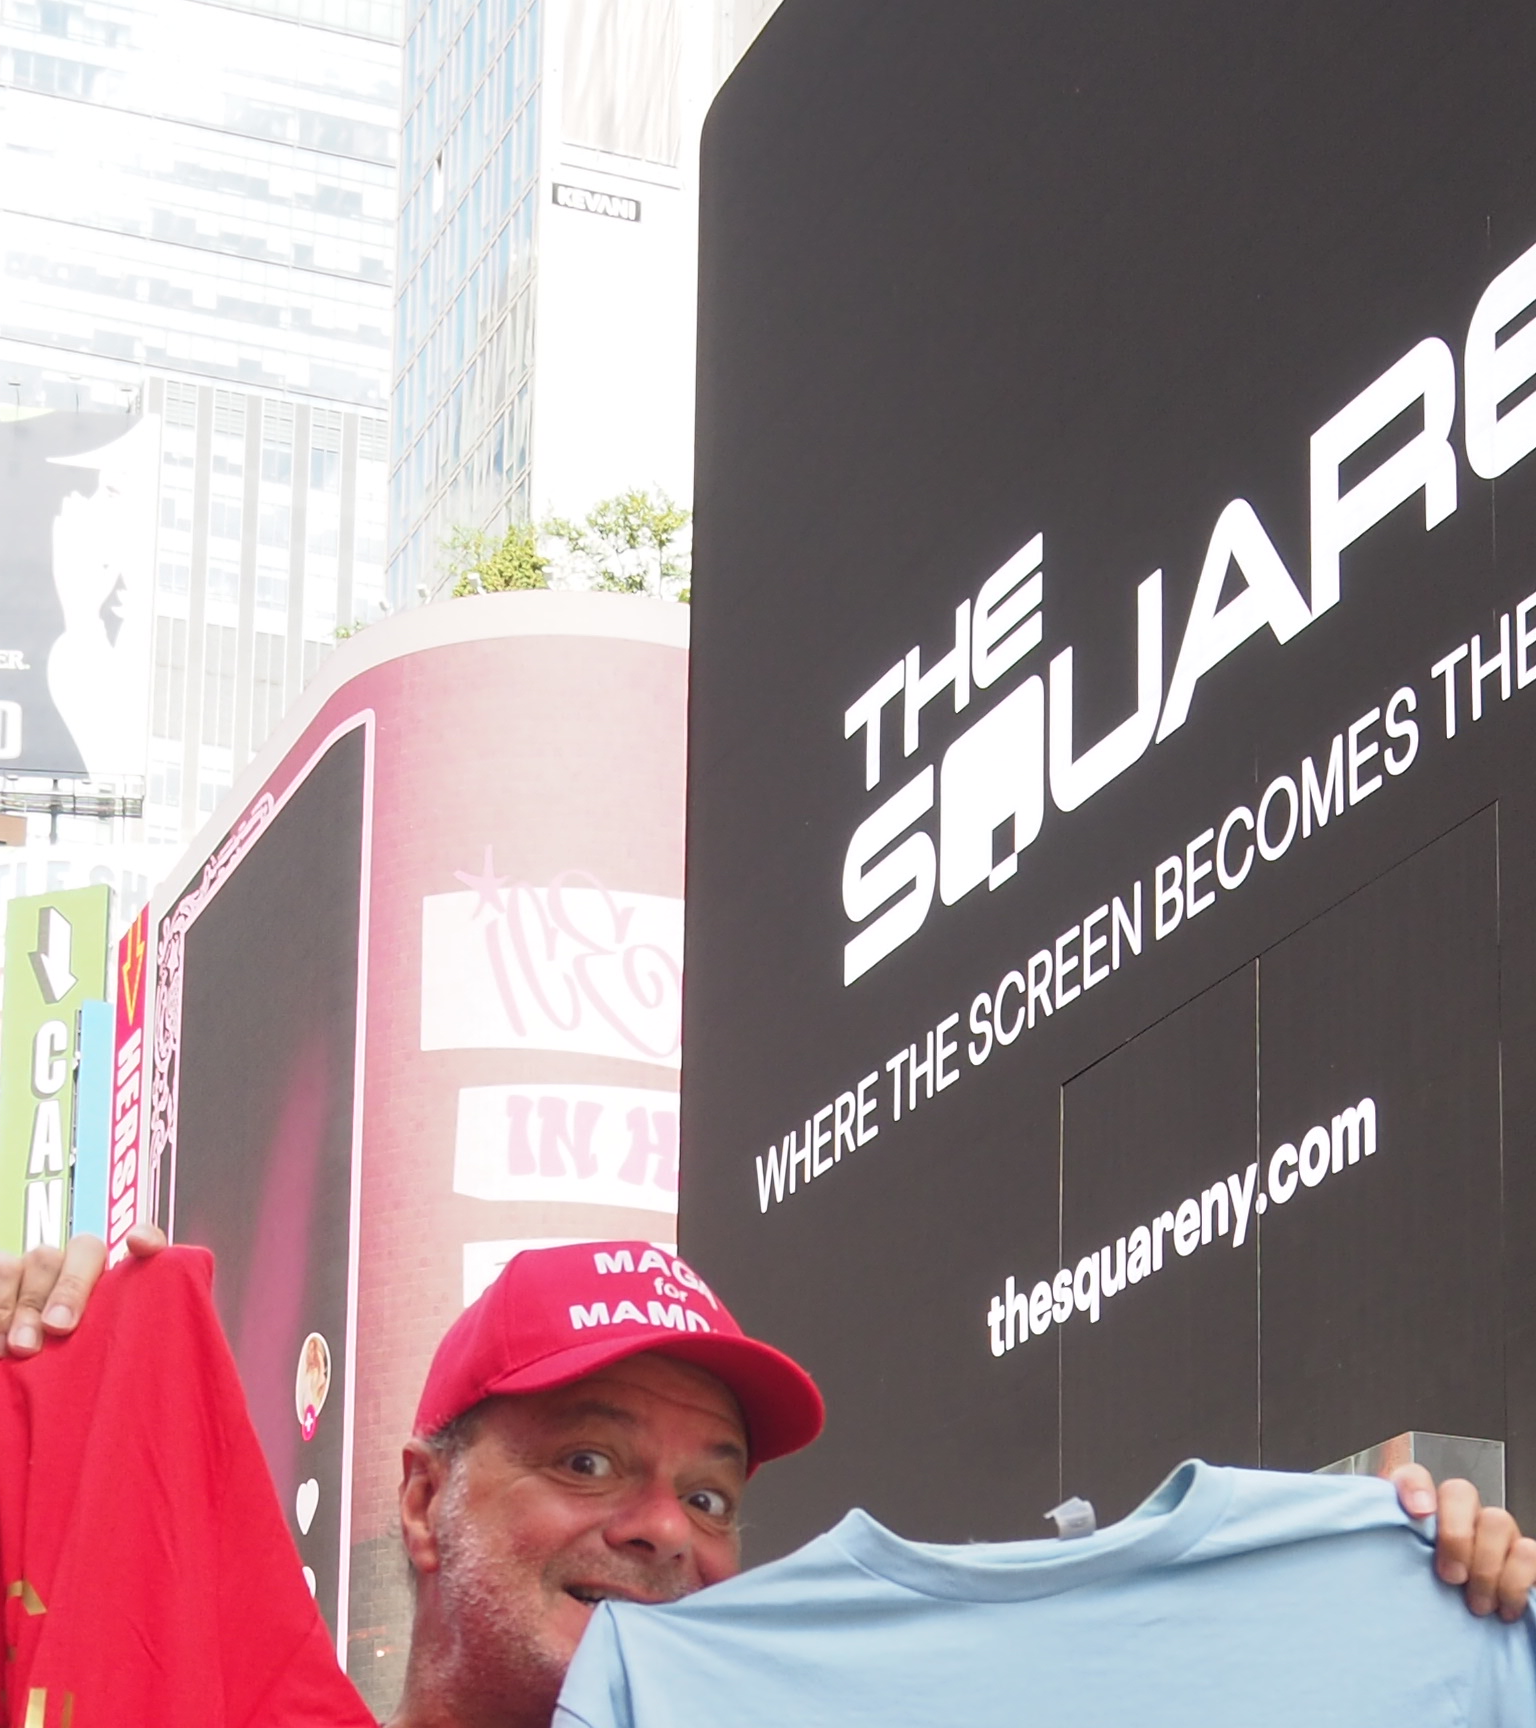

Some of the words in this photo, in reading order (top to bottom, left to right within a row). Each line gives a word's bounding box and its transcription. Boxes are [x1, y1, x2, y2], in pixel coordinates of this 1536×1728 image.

[557, 184, 636, 221] KEVANI
[843, 532, 1044, 791] THE
[755, 1072, 879, 1214] WHERE
[885, 1012, 960, 1124] THE
[967, 880, 1142, 1067] SCREEN
[1155, 686, 1418, 942] BECOMES
[106, 1026, 142, 1262] HERSH
[987, 1095, 1377, 1357] thesquareny.com
[569, 1300, 718, 1334] MAMD
[653, 1271, 689, 1303] for
